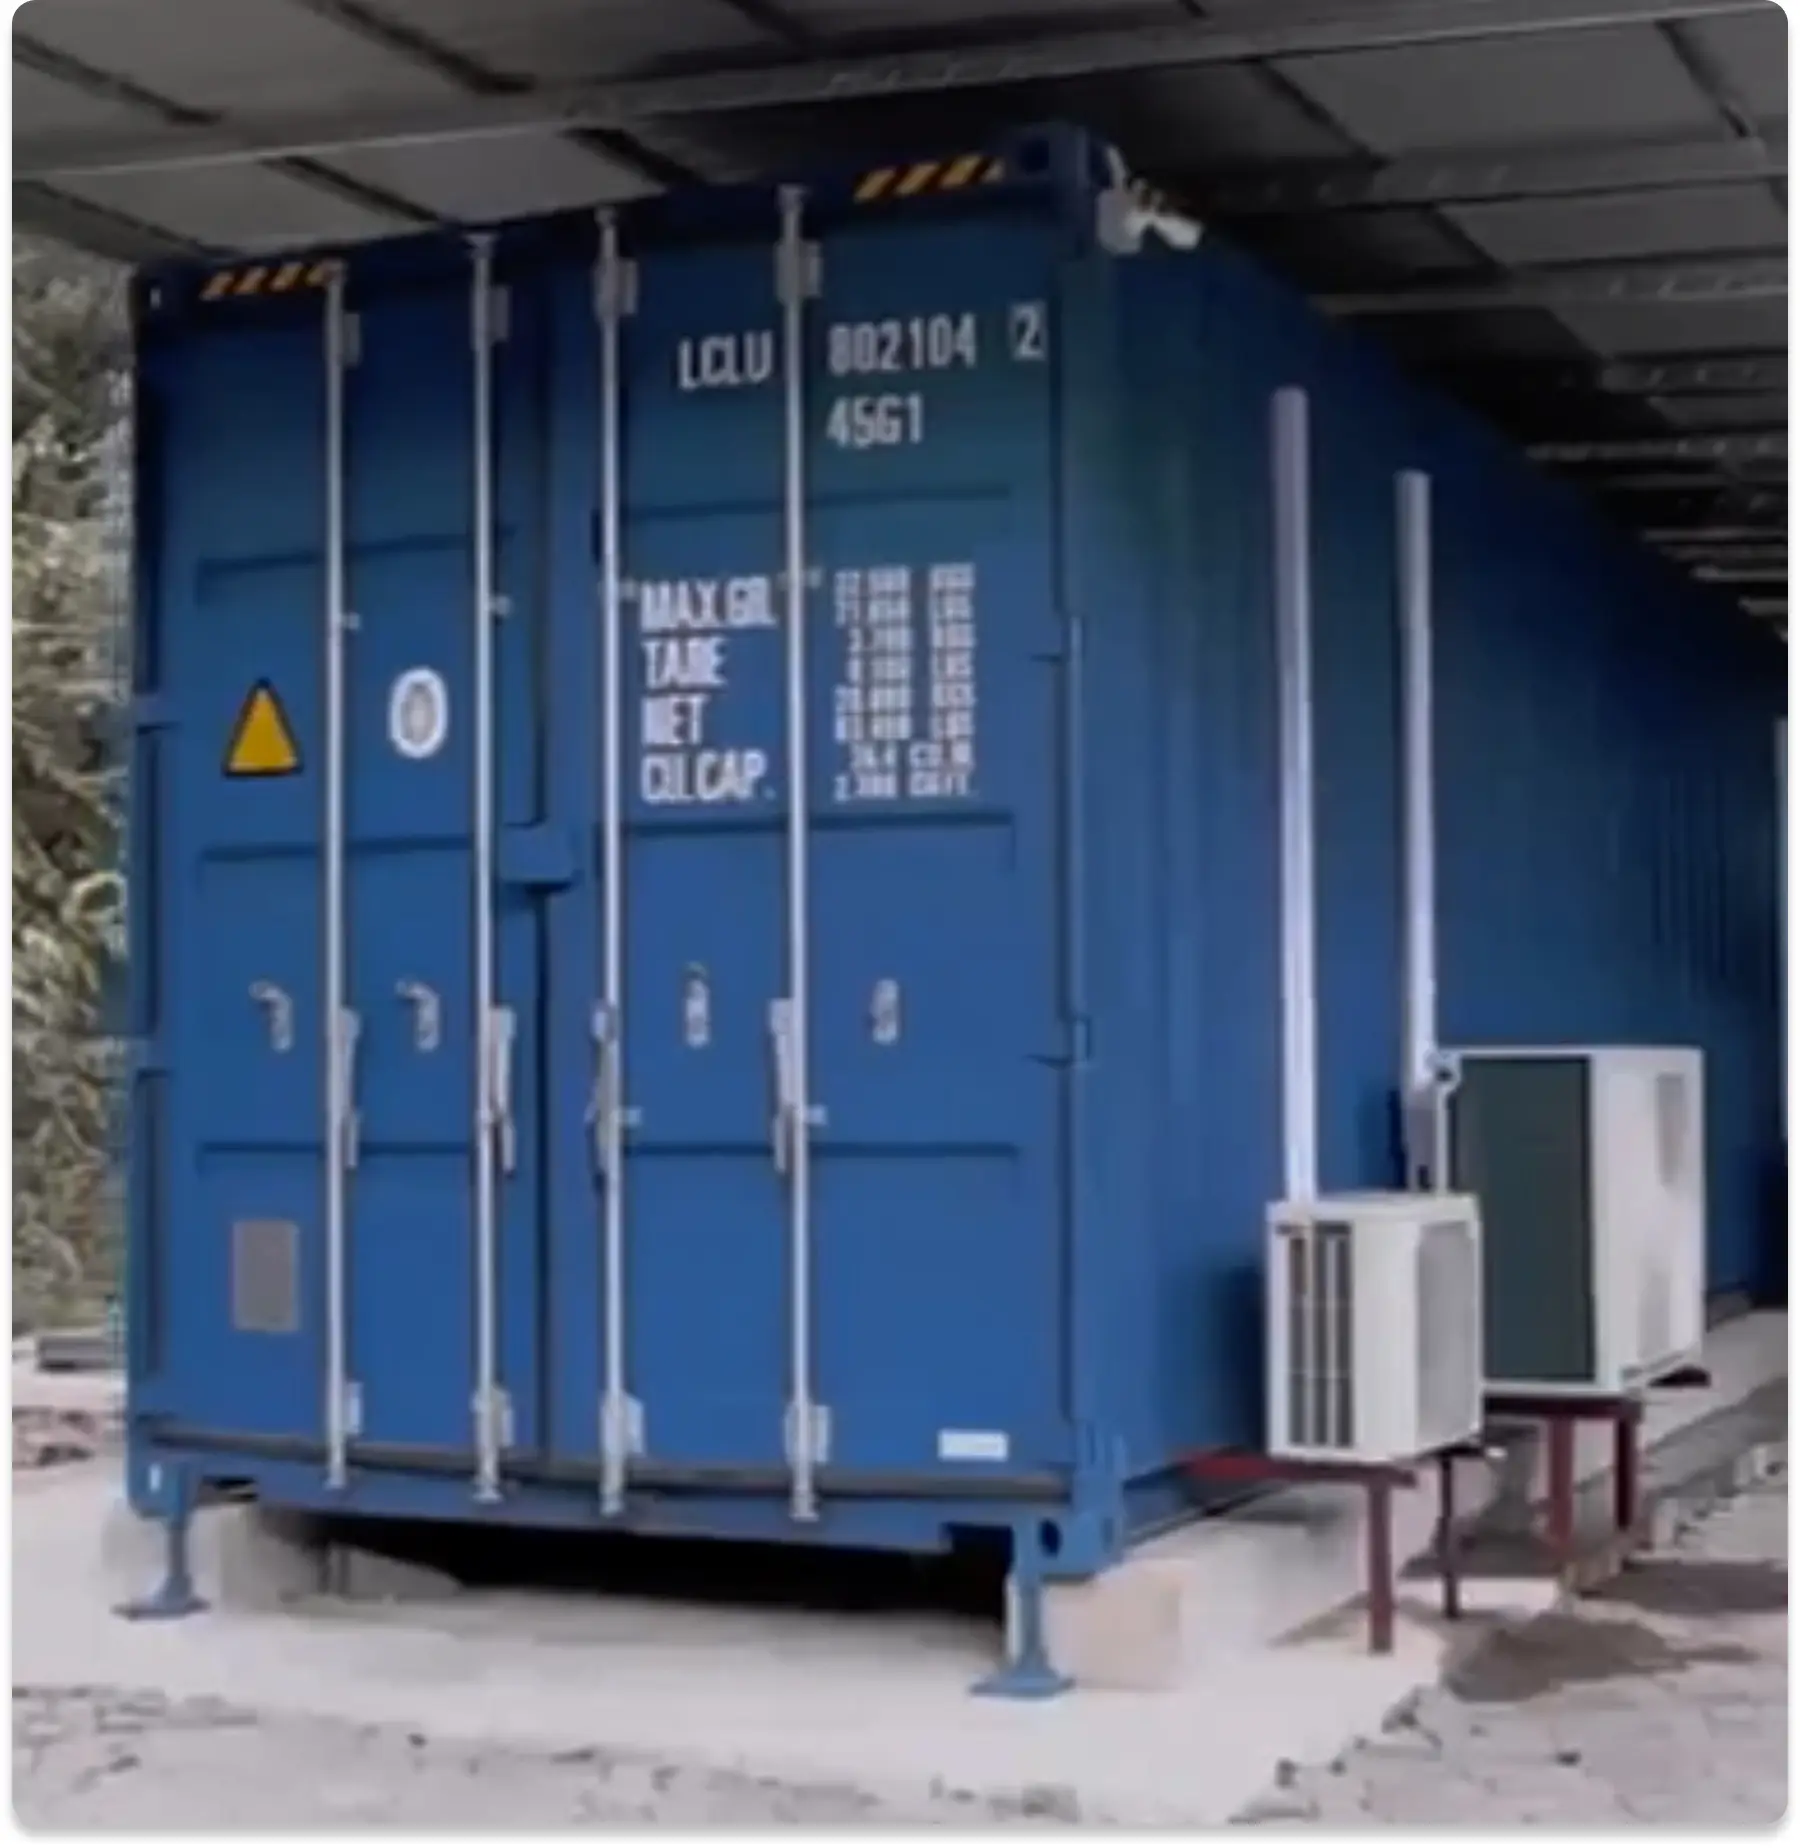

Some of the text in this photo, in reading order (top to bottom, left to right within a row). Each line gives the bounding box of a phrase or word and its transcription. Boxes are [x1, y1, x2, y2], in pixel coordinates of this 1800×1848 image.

[678, 302, 1046, 392] LCLU 802104 2
[826, 393, 923, 449] 45G1
